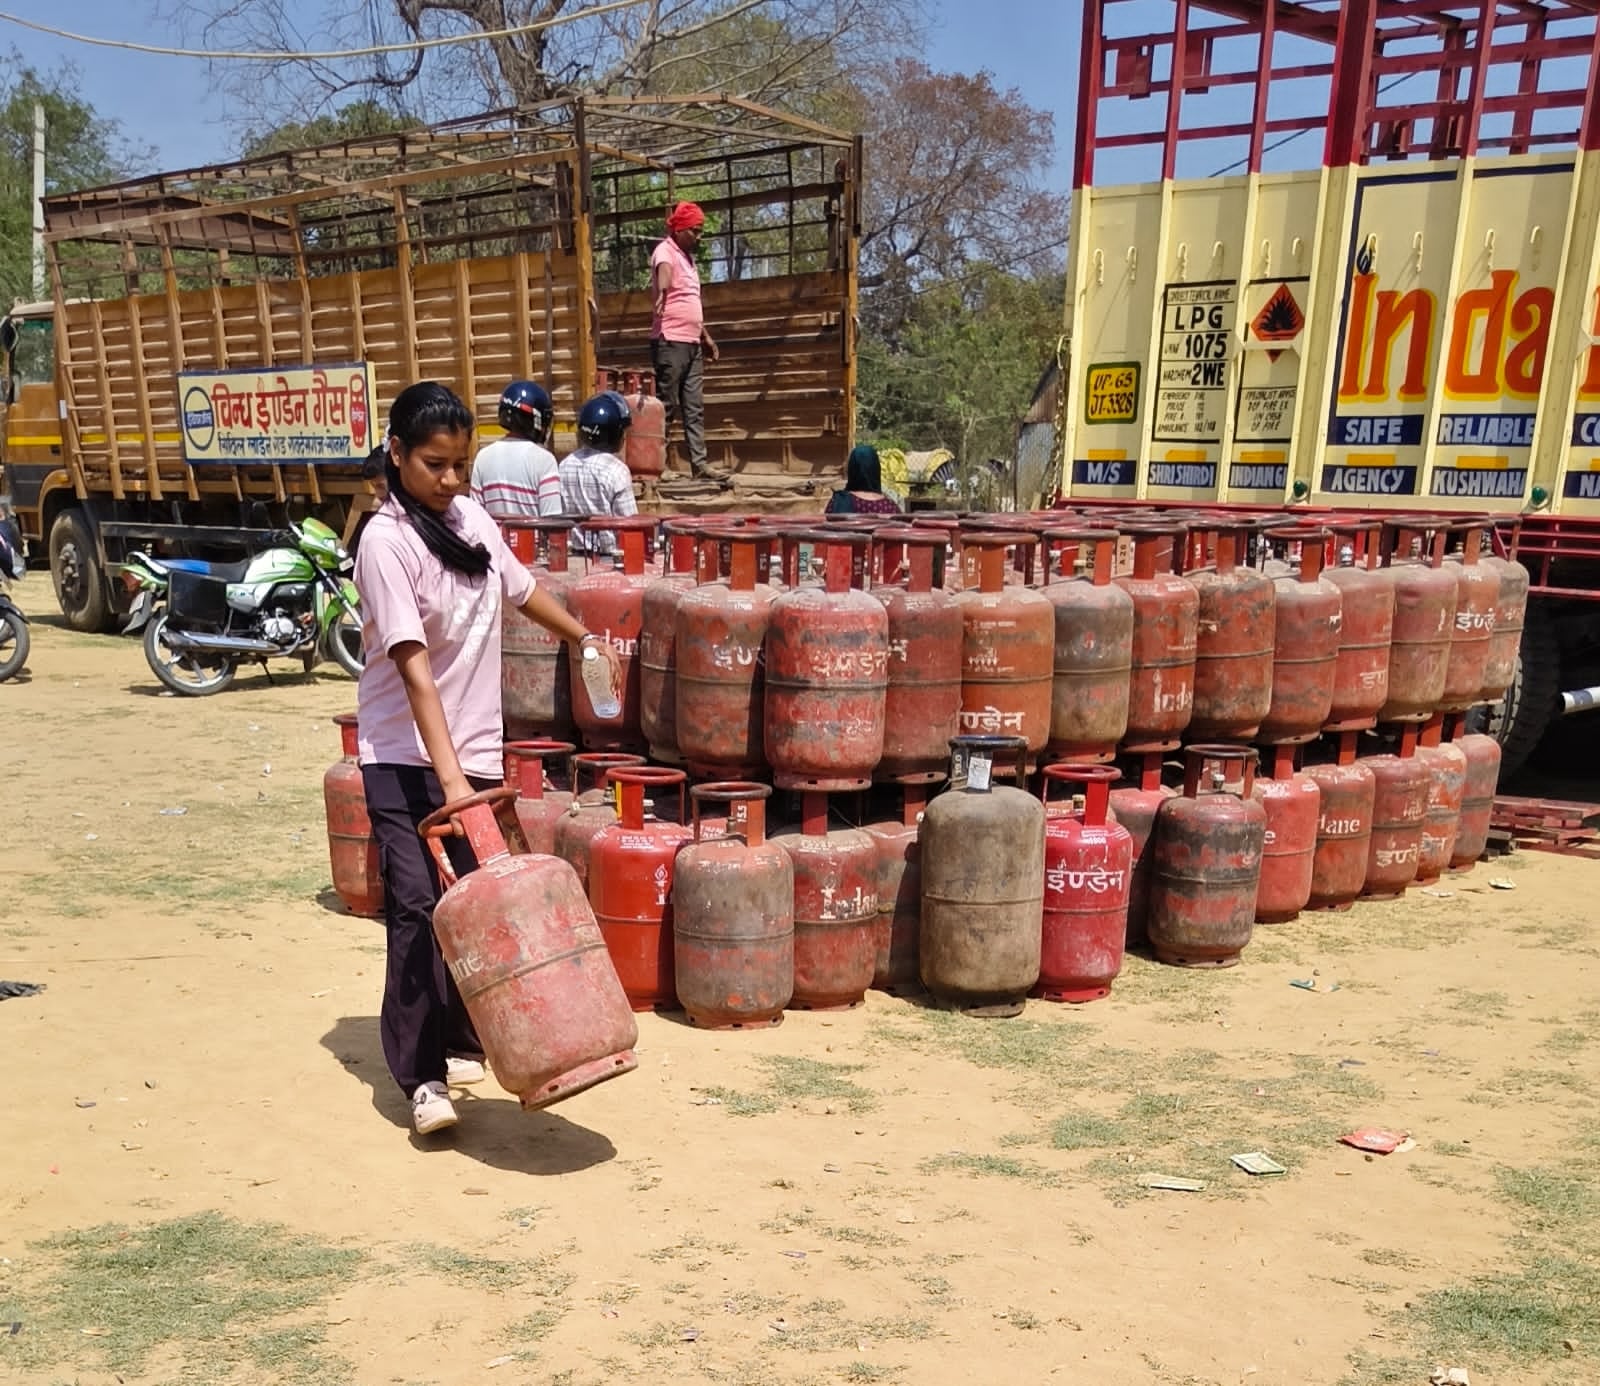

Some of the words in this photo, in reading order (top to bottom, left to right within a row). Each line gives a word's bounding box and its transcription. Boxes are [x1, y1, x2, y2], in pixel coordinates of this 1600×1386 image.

[1175, 306, 1224, 330] LPG
[1186, 333, 1227, 358] 1075
[1191, 363, 1225, 386] 2WE
[1344, 418, 1404, 443] SAFE
[1438, 417, 1536, 444] RELIABLE
[1088, 462, 1122, 483] M/S
[1231, 465, 1274, 487] INDIAN
[1331, 467, 1405, 493] AGENCY
